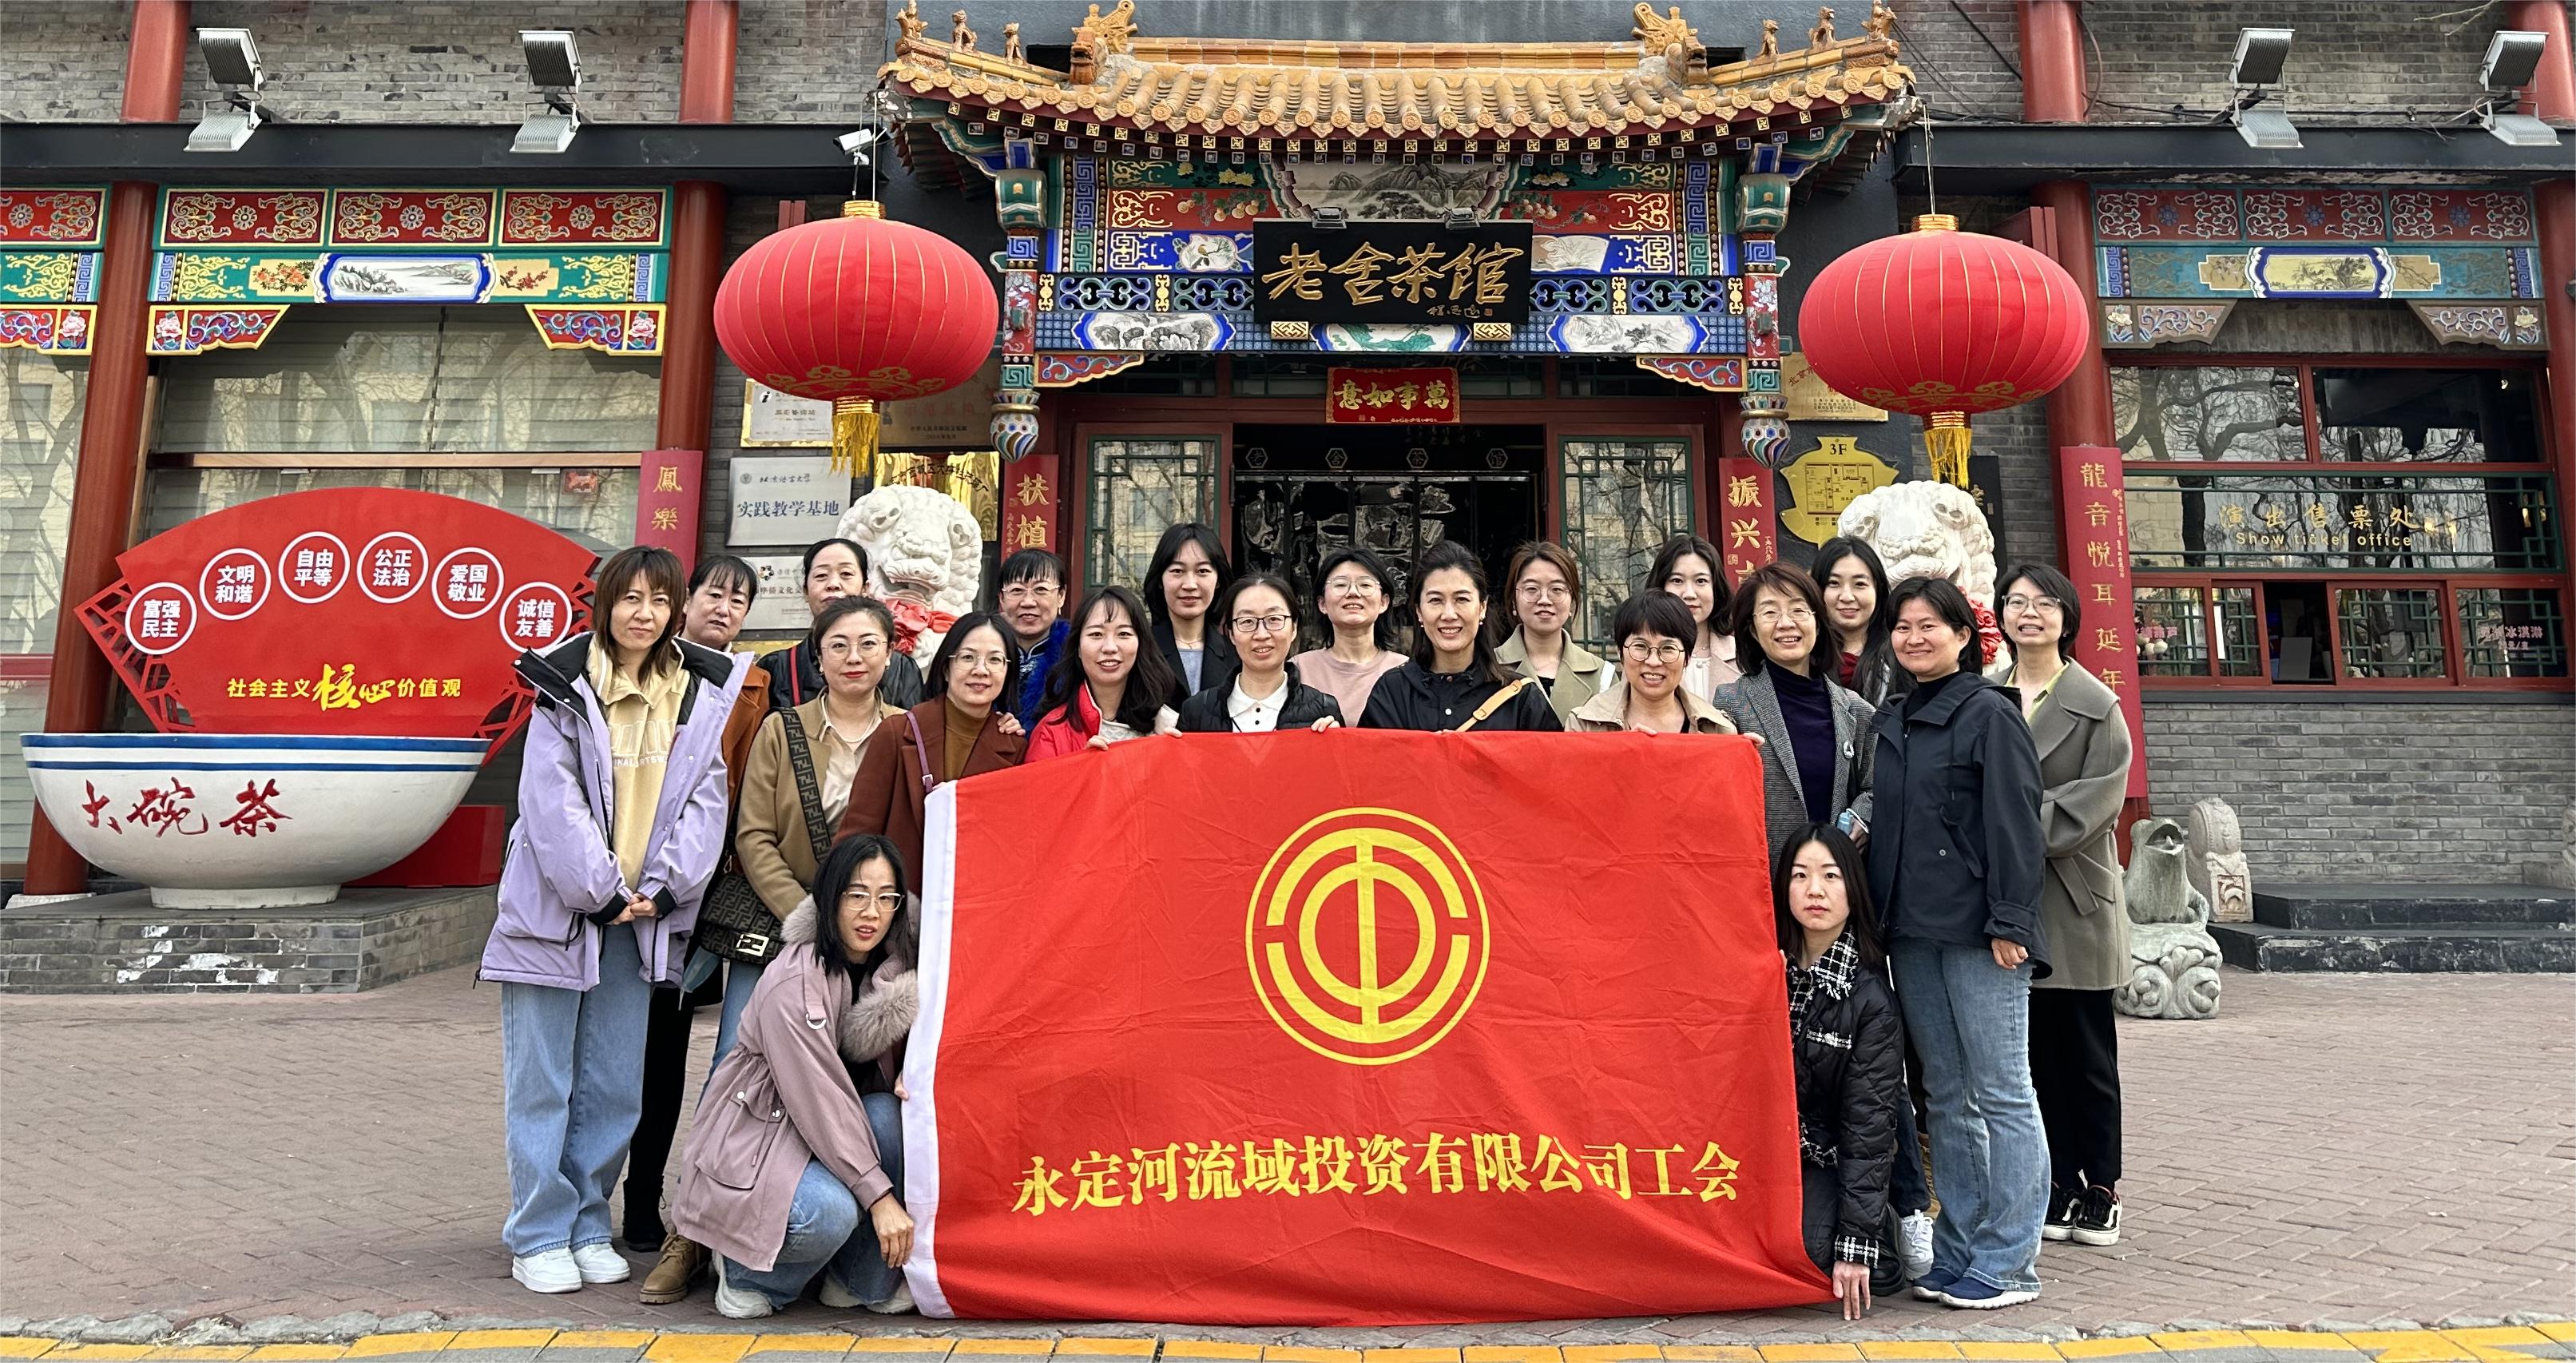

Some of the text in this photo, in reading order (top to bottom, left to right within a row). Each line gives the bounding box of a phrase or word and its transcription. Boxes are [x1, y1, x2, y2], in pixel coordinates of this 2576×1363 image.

[1261, 241, 1524, 305] 老舍茶馆
[1829, 443, 1848, 455] 3F
[651, 466, 683, 551] 鳳樂
[737, 500, 839, 518] 实践教学基地
[1014, 473, 1050, 549] 扶植
[2219, 503, 2420, 530] 演出售票处
[2236, 533, 2413, 546] Show ticket office
[296, 550, 334, 568] 自由
[375, 549, 412, 567] 公正
[216, 565, 256, 584] 文明
[294, 567, 332, 587] 平等
[372, 567, 411, 587] 法治
[450, 564, 488, 583] 爱国
[215, 584, 253, 604] 和谐
[447, 583, 486, 602] 敬业
[143, 599, 181, 619] 富强
[518, 599, 556, 618] 诚信
[141, 619, 179, 638] 民主
[515, 618, 554, 638] 友善
[227, 663, 462, 711] 社会主义核心价值观
[80, 777, 293, 838] 大碗茶
[1010, 1132, 1740, 1217] 永定河流域投资有限公司工会
